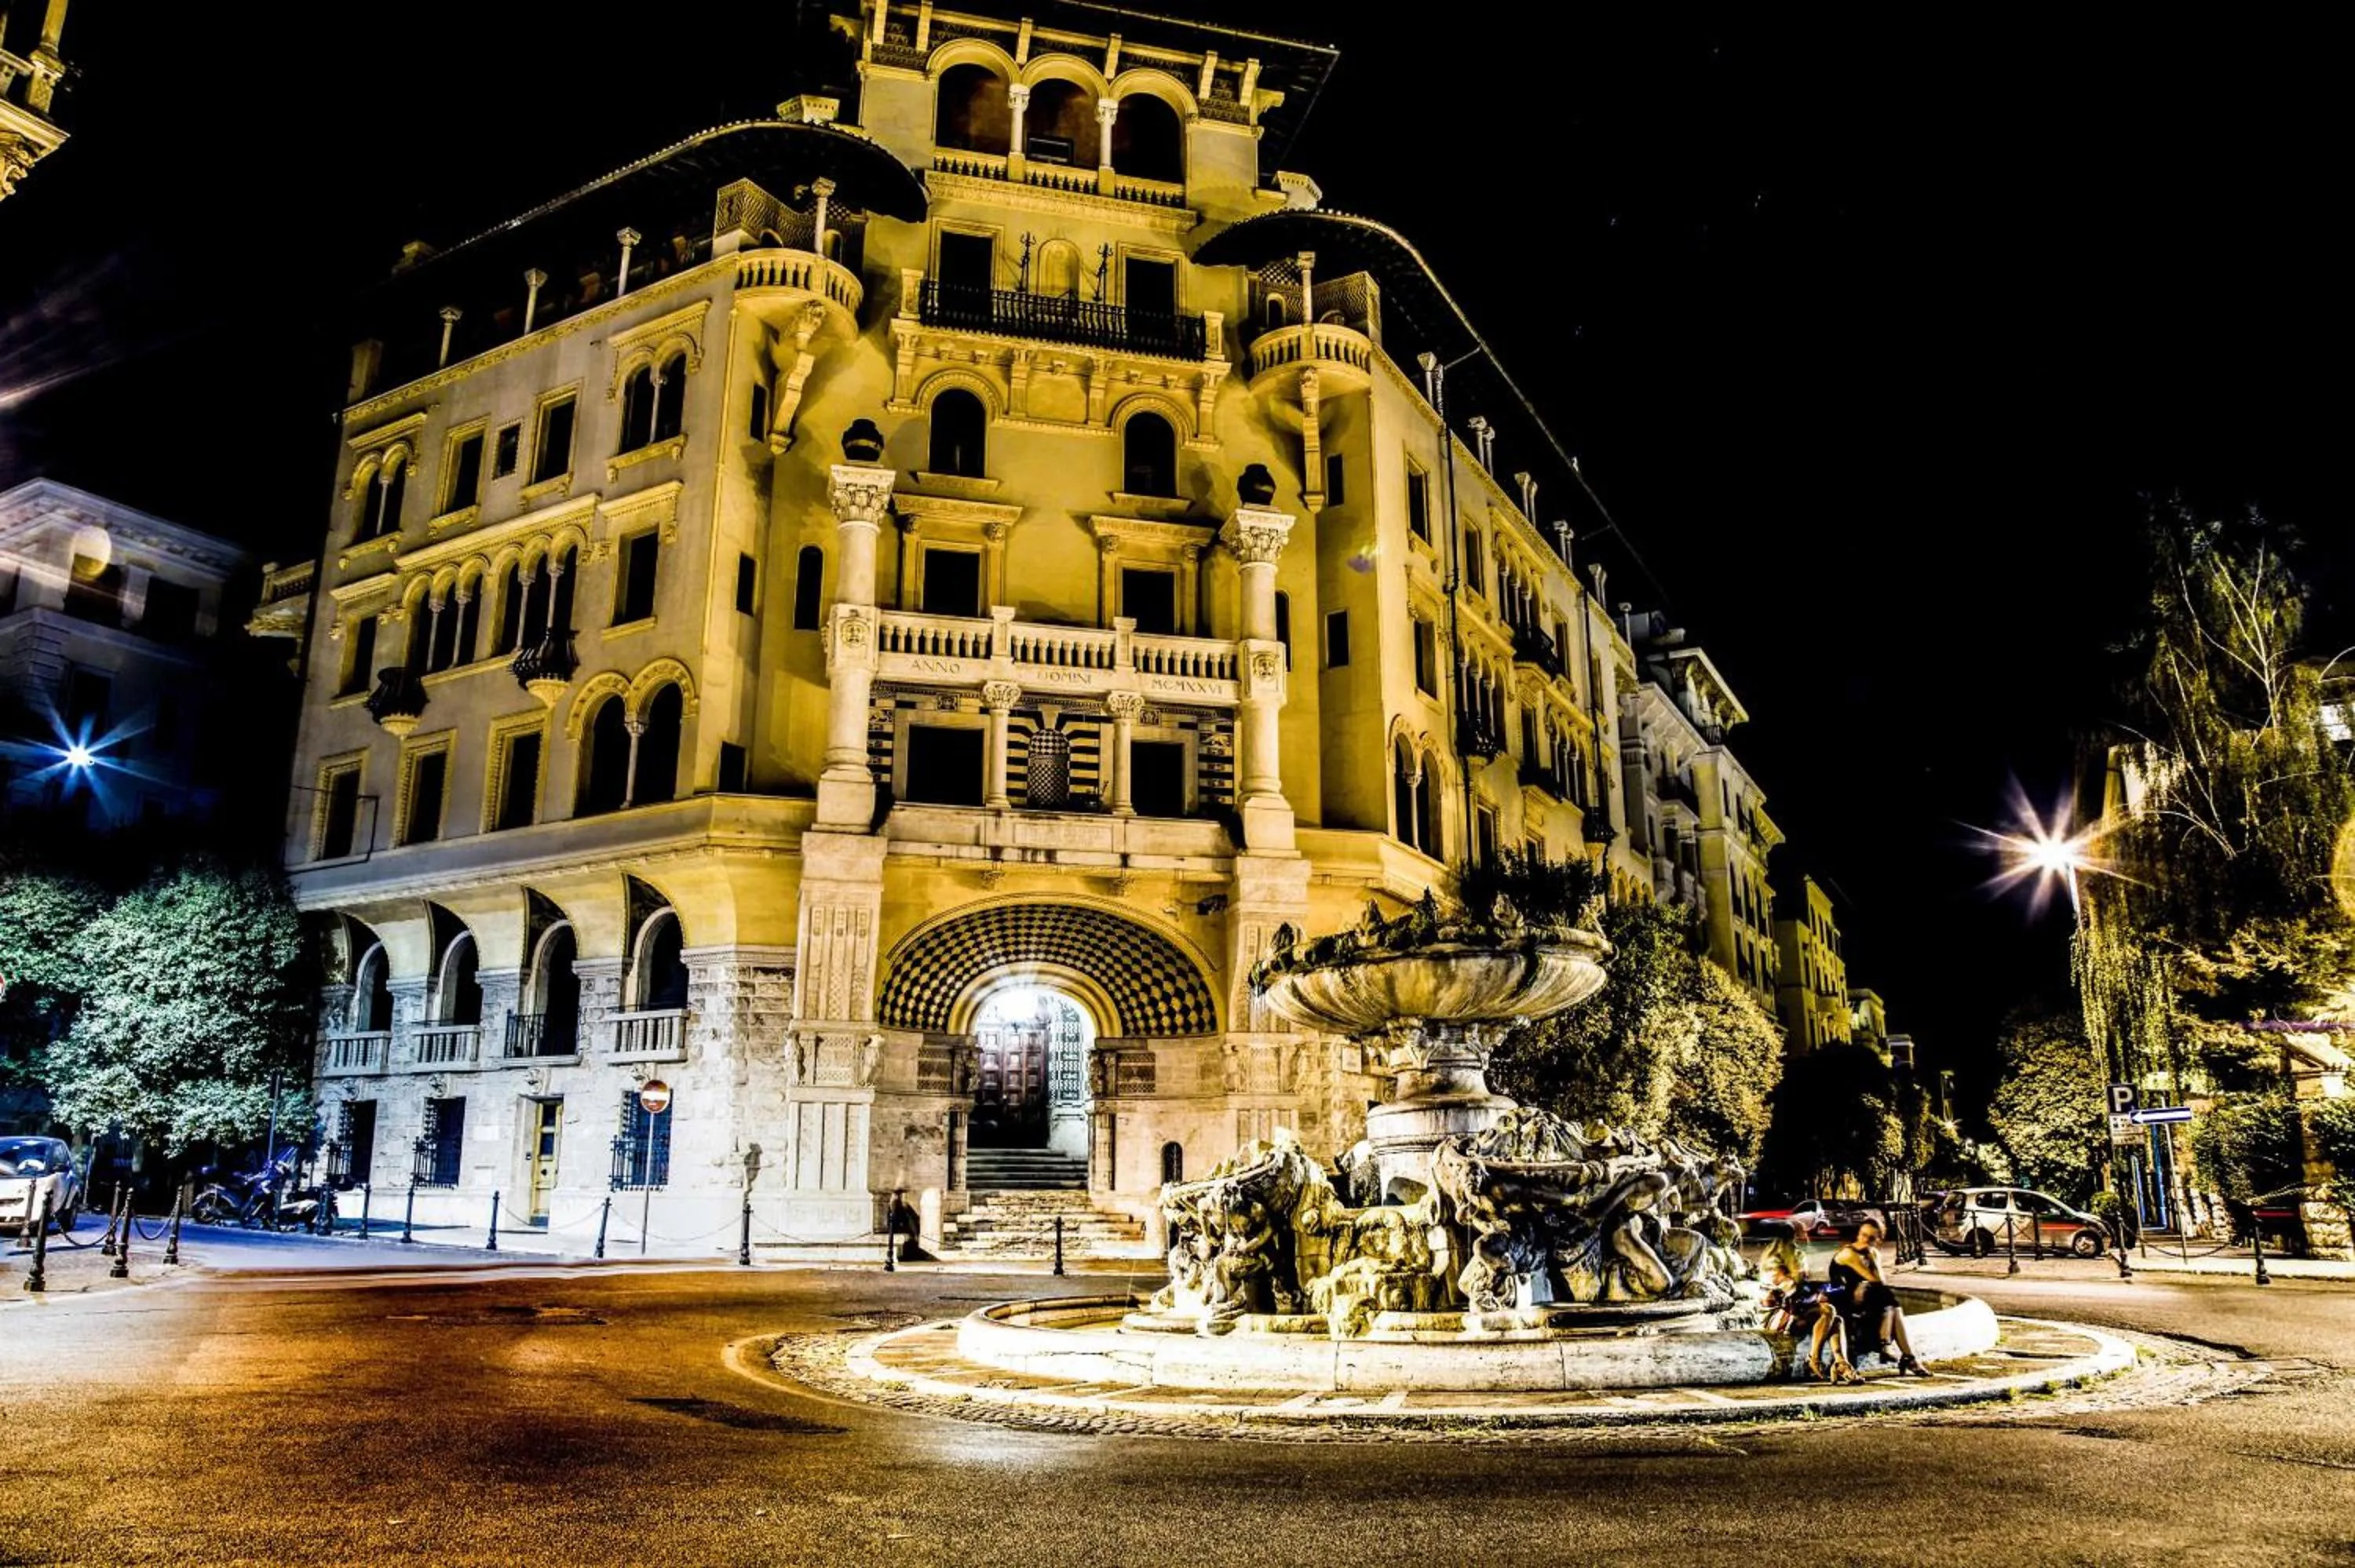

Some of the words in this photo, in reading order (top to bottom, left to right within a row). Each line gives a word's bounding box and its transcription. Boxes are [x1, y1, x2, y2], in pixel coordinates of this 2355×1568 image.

[911, 659, 960, 673] ANNO
[1151, 678, 1222, 695] MCMXXVI
[2112, 1086, 2133, 1112] P
